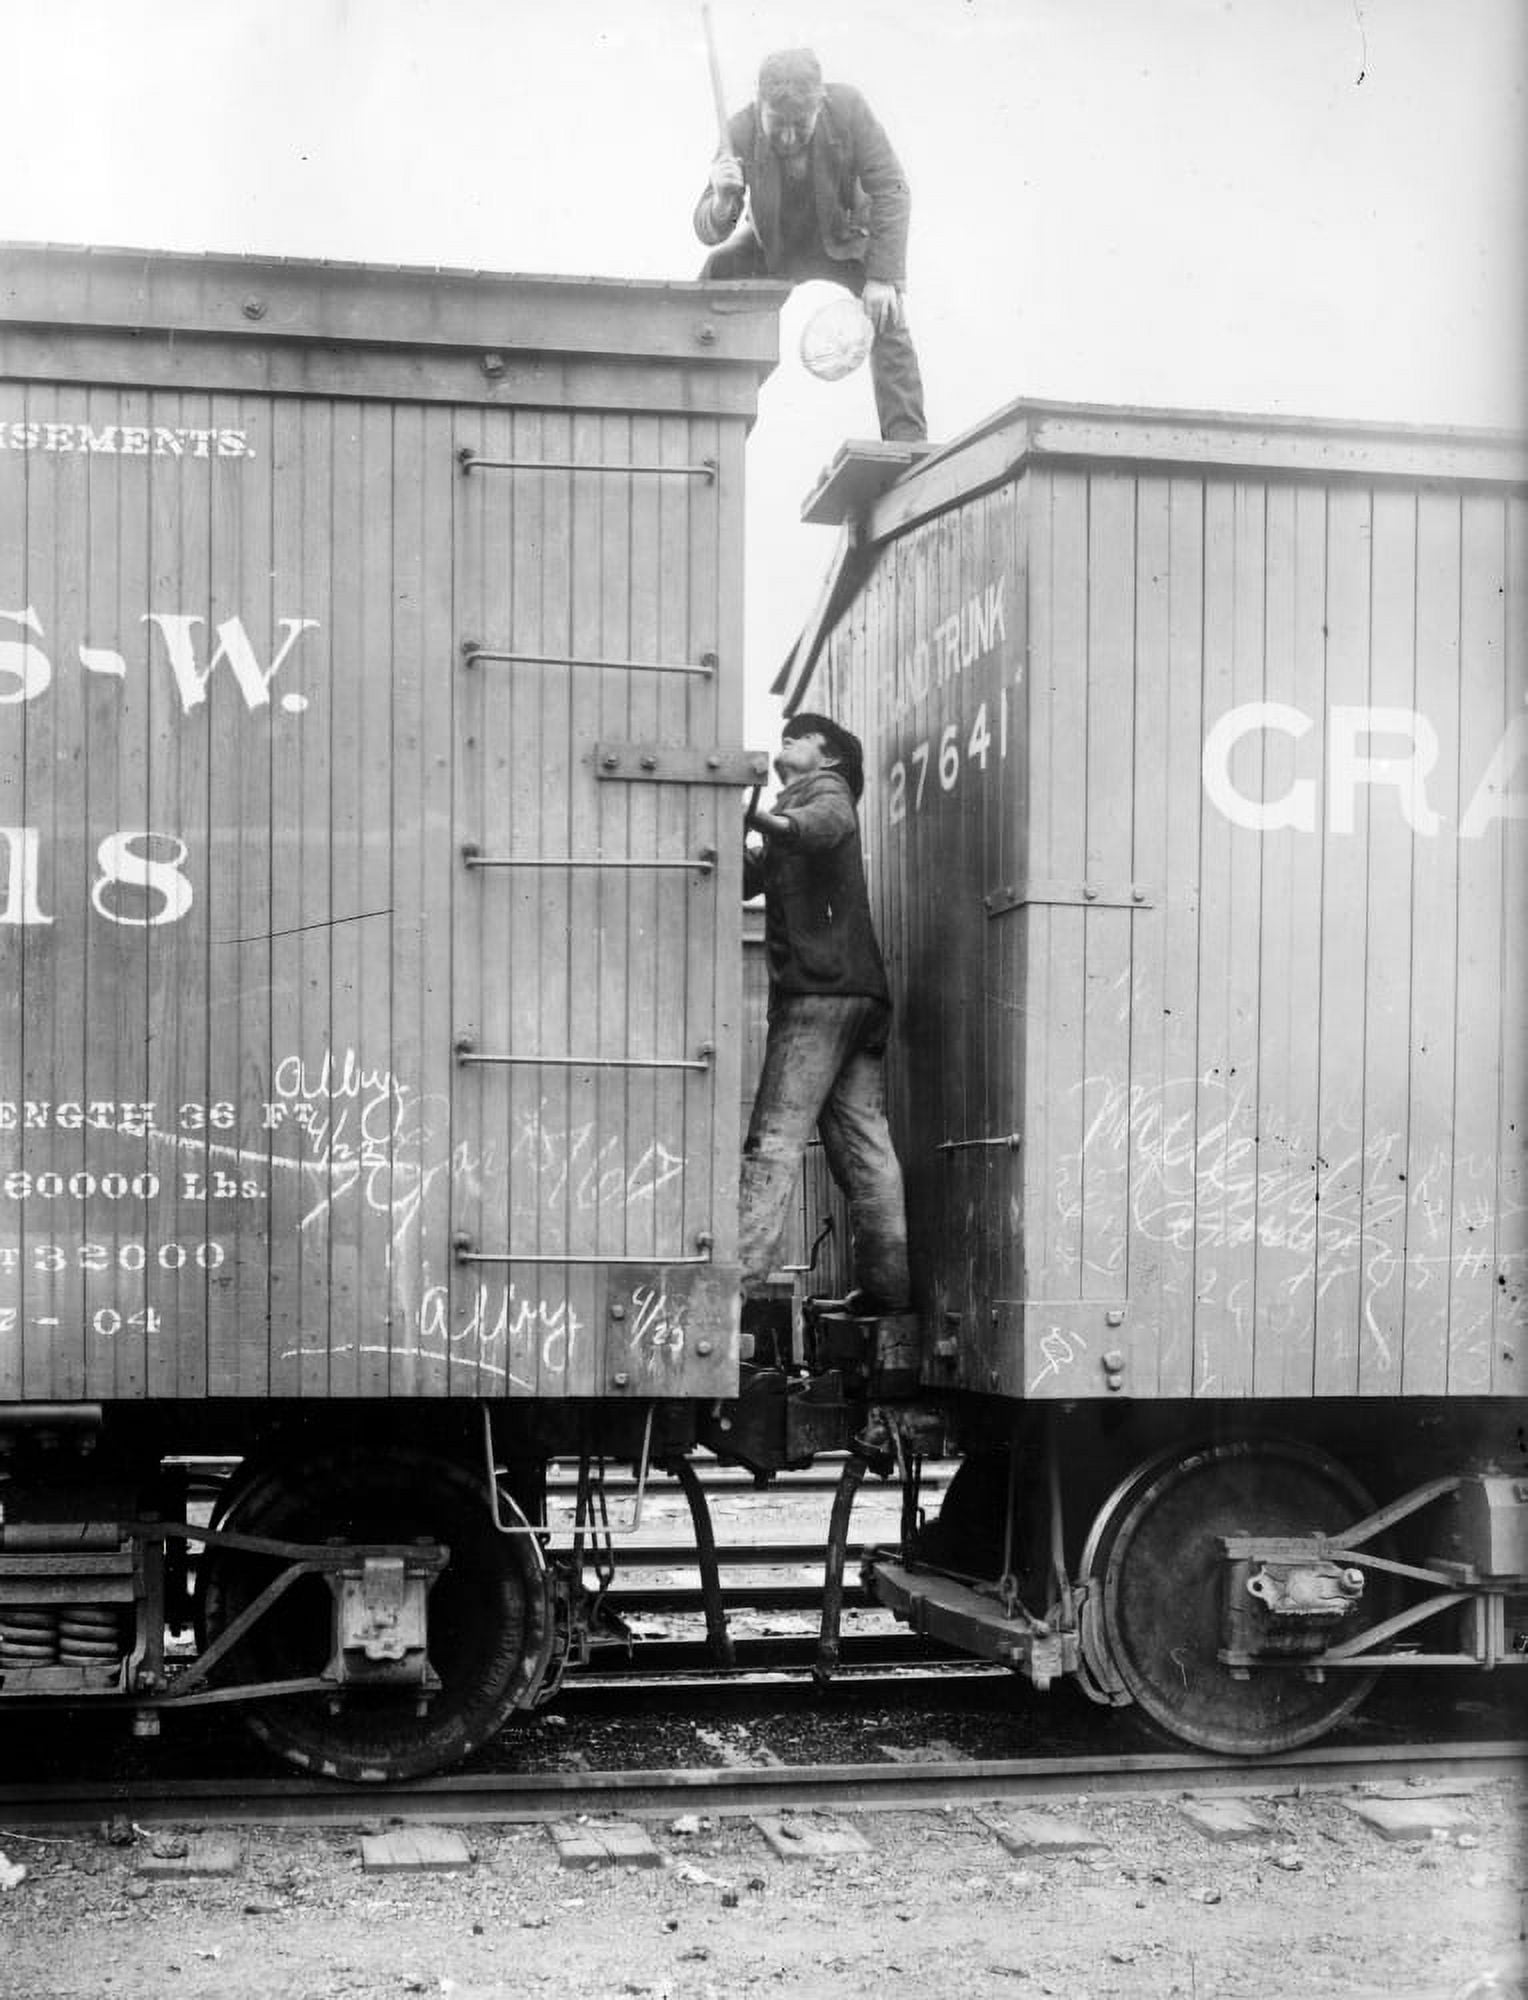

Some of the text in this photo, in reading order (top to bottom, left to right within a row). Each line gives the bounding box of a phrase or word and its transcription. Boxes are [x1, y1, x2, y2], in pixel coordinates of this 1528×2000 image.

[934, 575, 1006, 686] TRUNK
[889, 688, 1008, 825] 27641
[0, 827, 193, 926] 18
[179, 1103, 235, 1129] 36
[182, 1171, 267, 1200] Lbs.
[33, 1242, 225, 1271] 32000
[93, 1306, 161, 1335] 04
